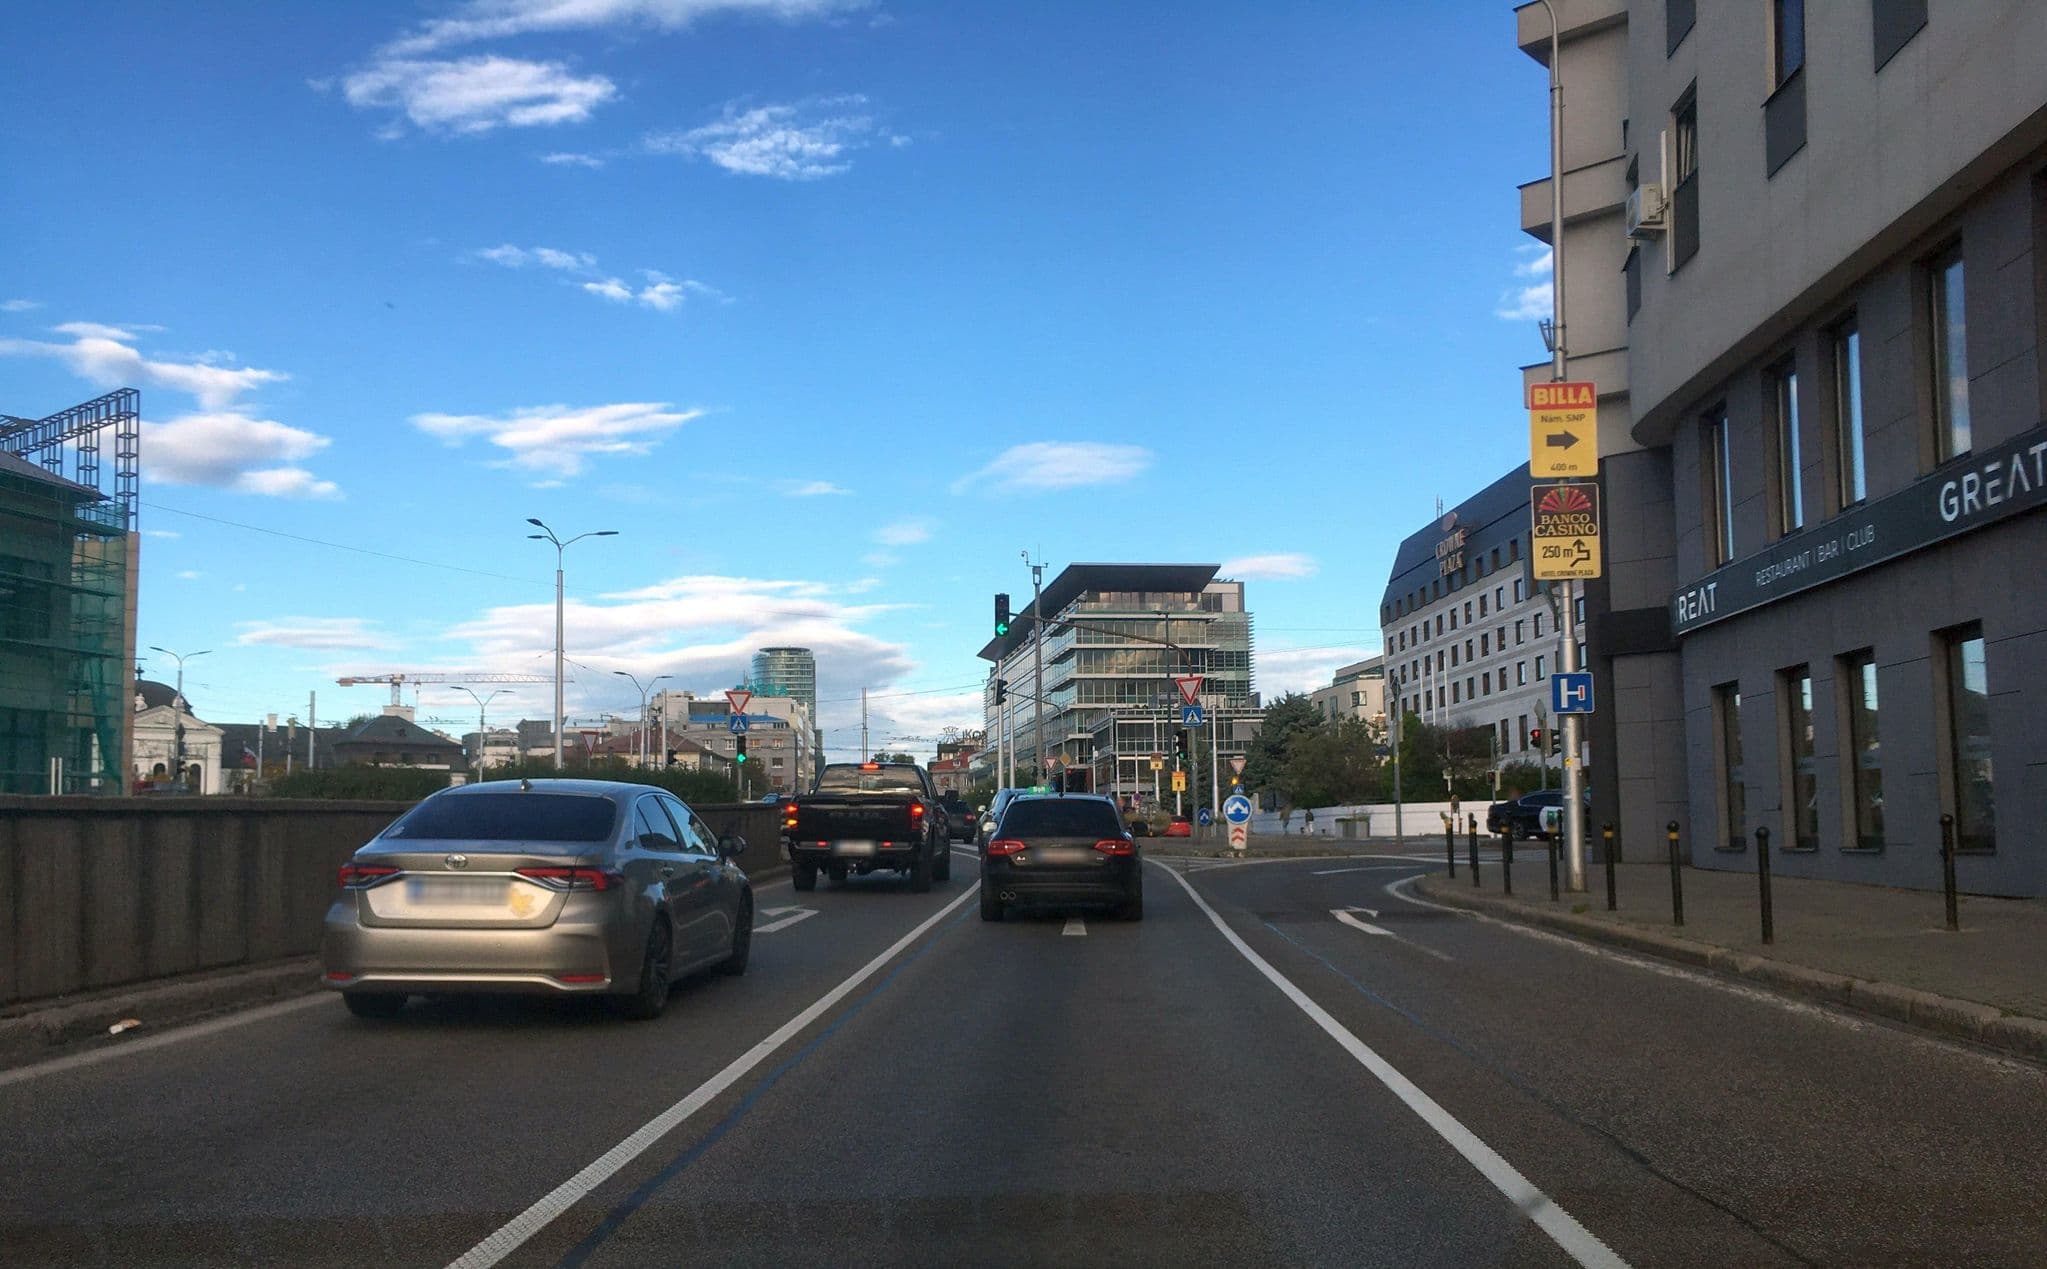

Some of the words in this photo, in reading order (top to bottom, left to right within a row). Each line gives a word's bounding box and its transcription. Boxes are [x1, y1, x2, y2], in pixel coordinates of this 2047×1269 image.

[1533, 387, 1593, 406] BILLA
[1566, 413, 1586, 423] SNP
[1550, 463, 1567, 471] 400
[1938, 441, 2047, 523] GREAT
[1541, 513, 1590, 525] BANCO
[1535, 522, 1597, 536] CASINO
[1542, 545, 1561, 559] 250
[1562, 548, 1573, 558] m
[1754, 549, 1811, 587] RESTAURANT
[1817, 540, 1839, 563] BAR
[1845, 523, 1876, 552] CLUB
[1674, 582, 1718, 623] REAT
